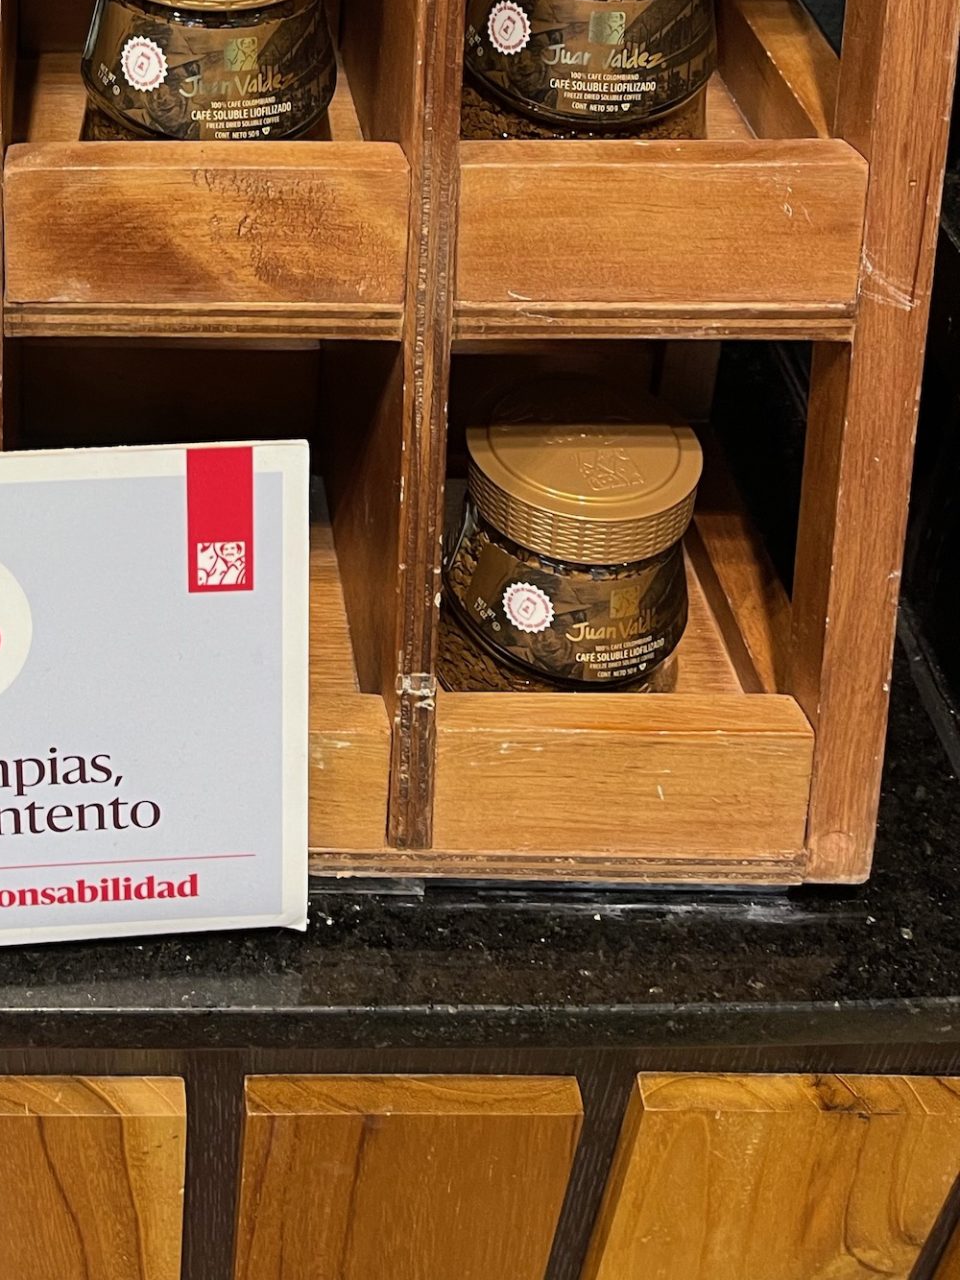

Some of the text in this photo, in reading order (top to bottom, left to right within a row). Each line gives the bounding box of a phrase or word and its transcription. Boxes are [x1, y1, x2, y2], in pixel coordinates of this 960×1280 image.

[234, 71, 297, 96] Valdez
[549, 78, 656, 92] CAFÉ SOLUBLE LIOFILIZADO
[191, 101, 292, 120] CAFÉ SOLUBLE LIOFILIZADO
[565, 621, 616, 642] Juan
[575, 652, 596, 662] CAFÉ
[596, 649, 628, 662] SOLUBLE
